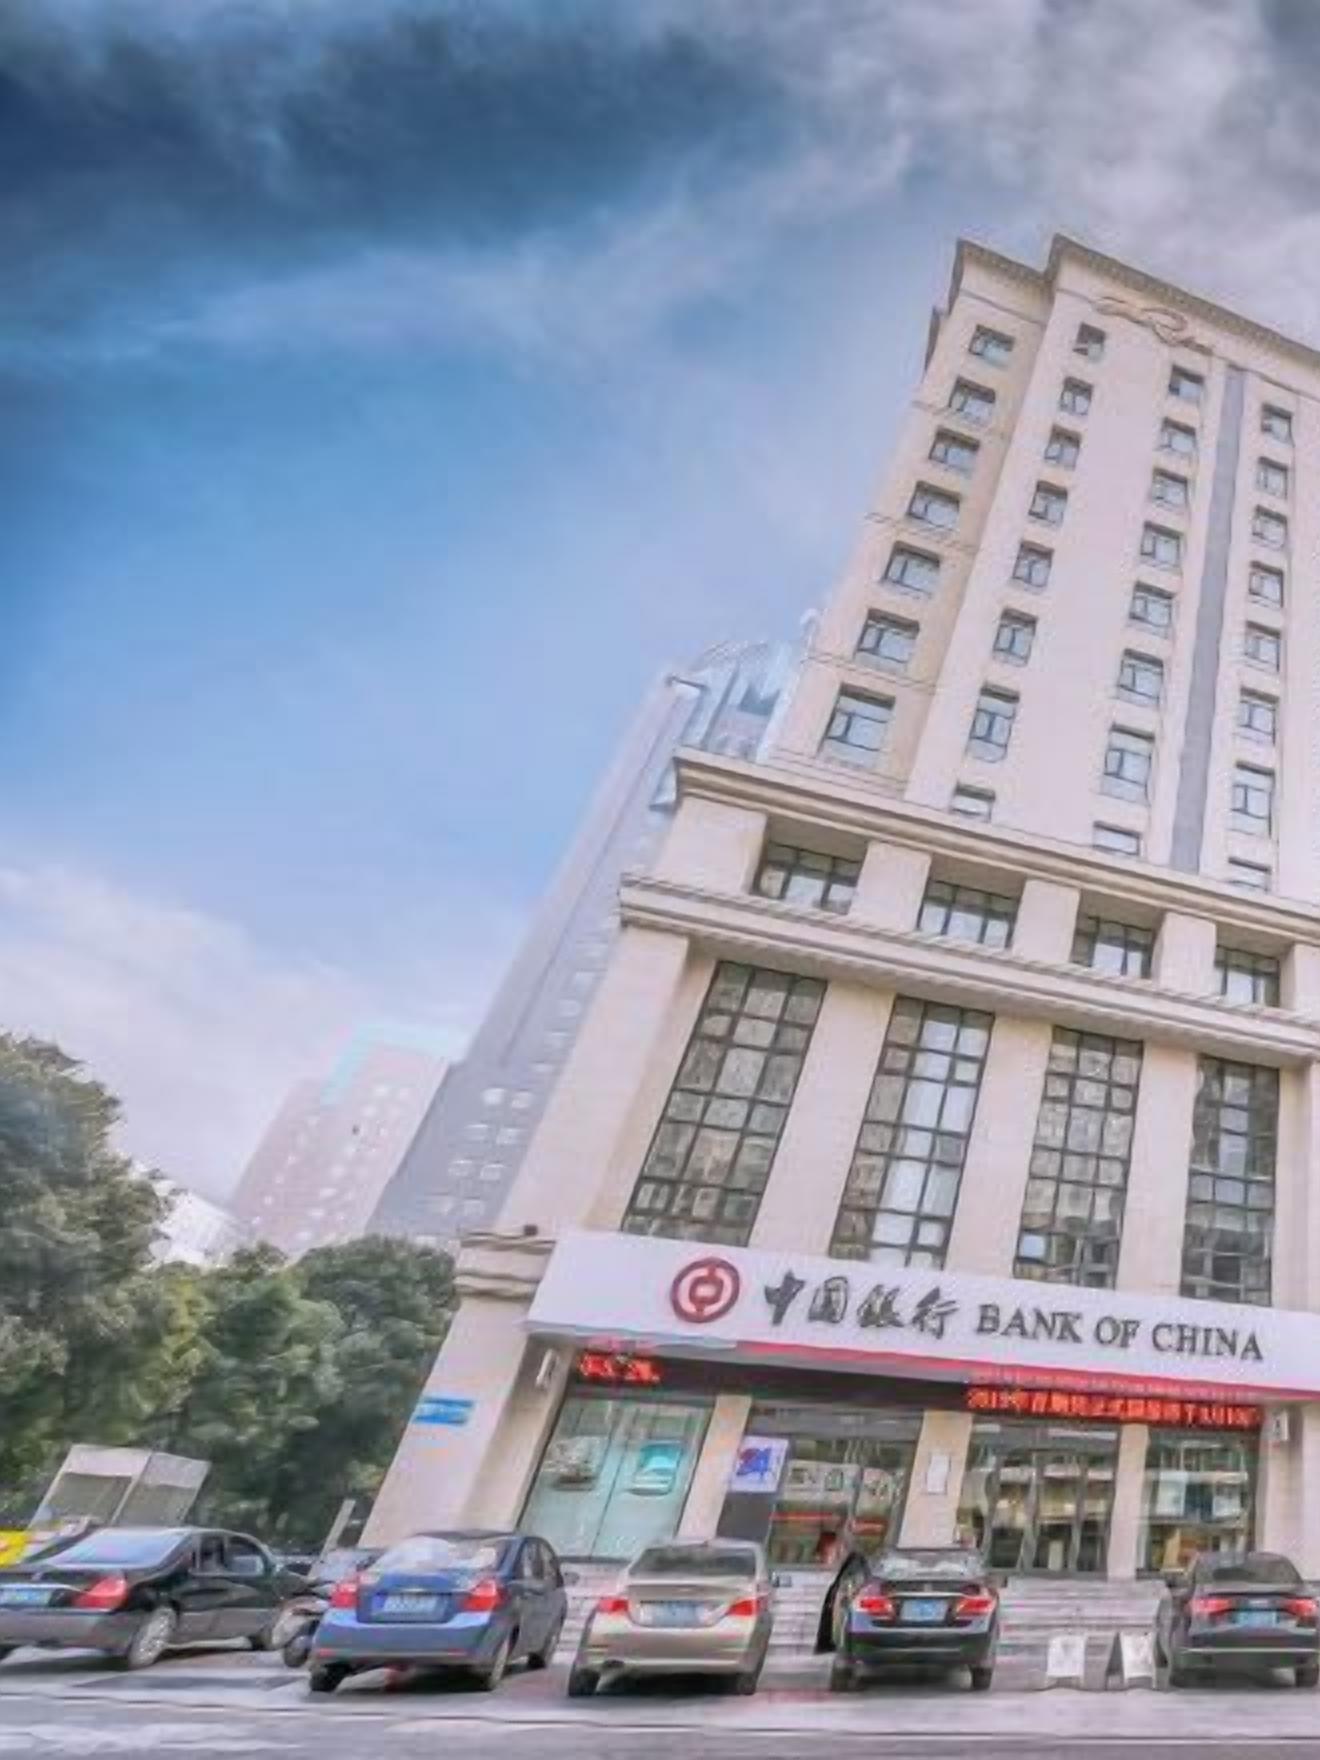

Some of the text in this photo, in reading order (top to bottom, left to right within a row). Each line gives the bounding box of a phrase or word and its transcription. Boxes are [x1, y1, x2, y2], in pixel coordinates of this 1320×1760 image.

[976, 1303, 1263, 1361] BANK OF CHINA
